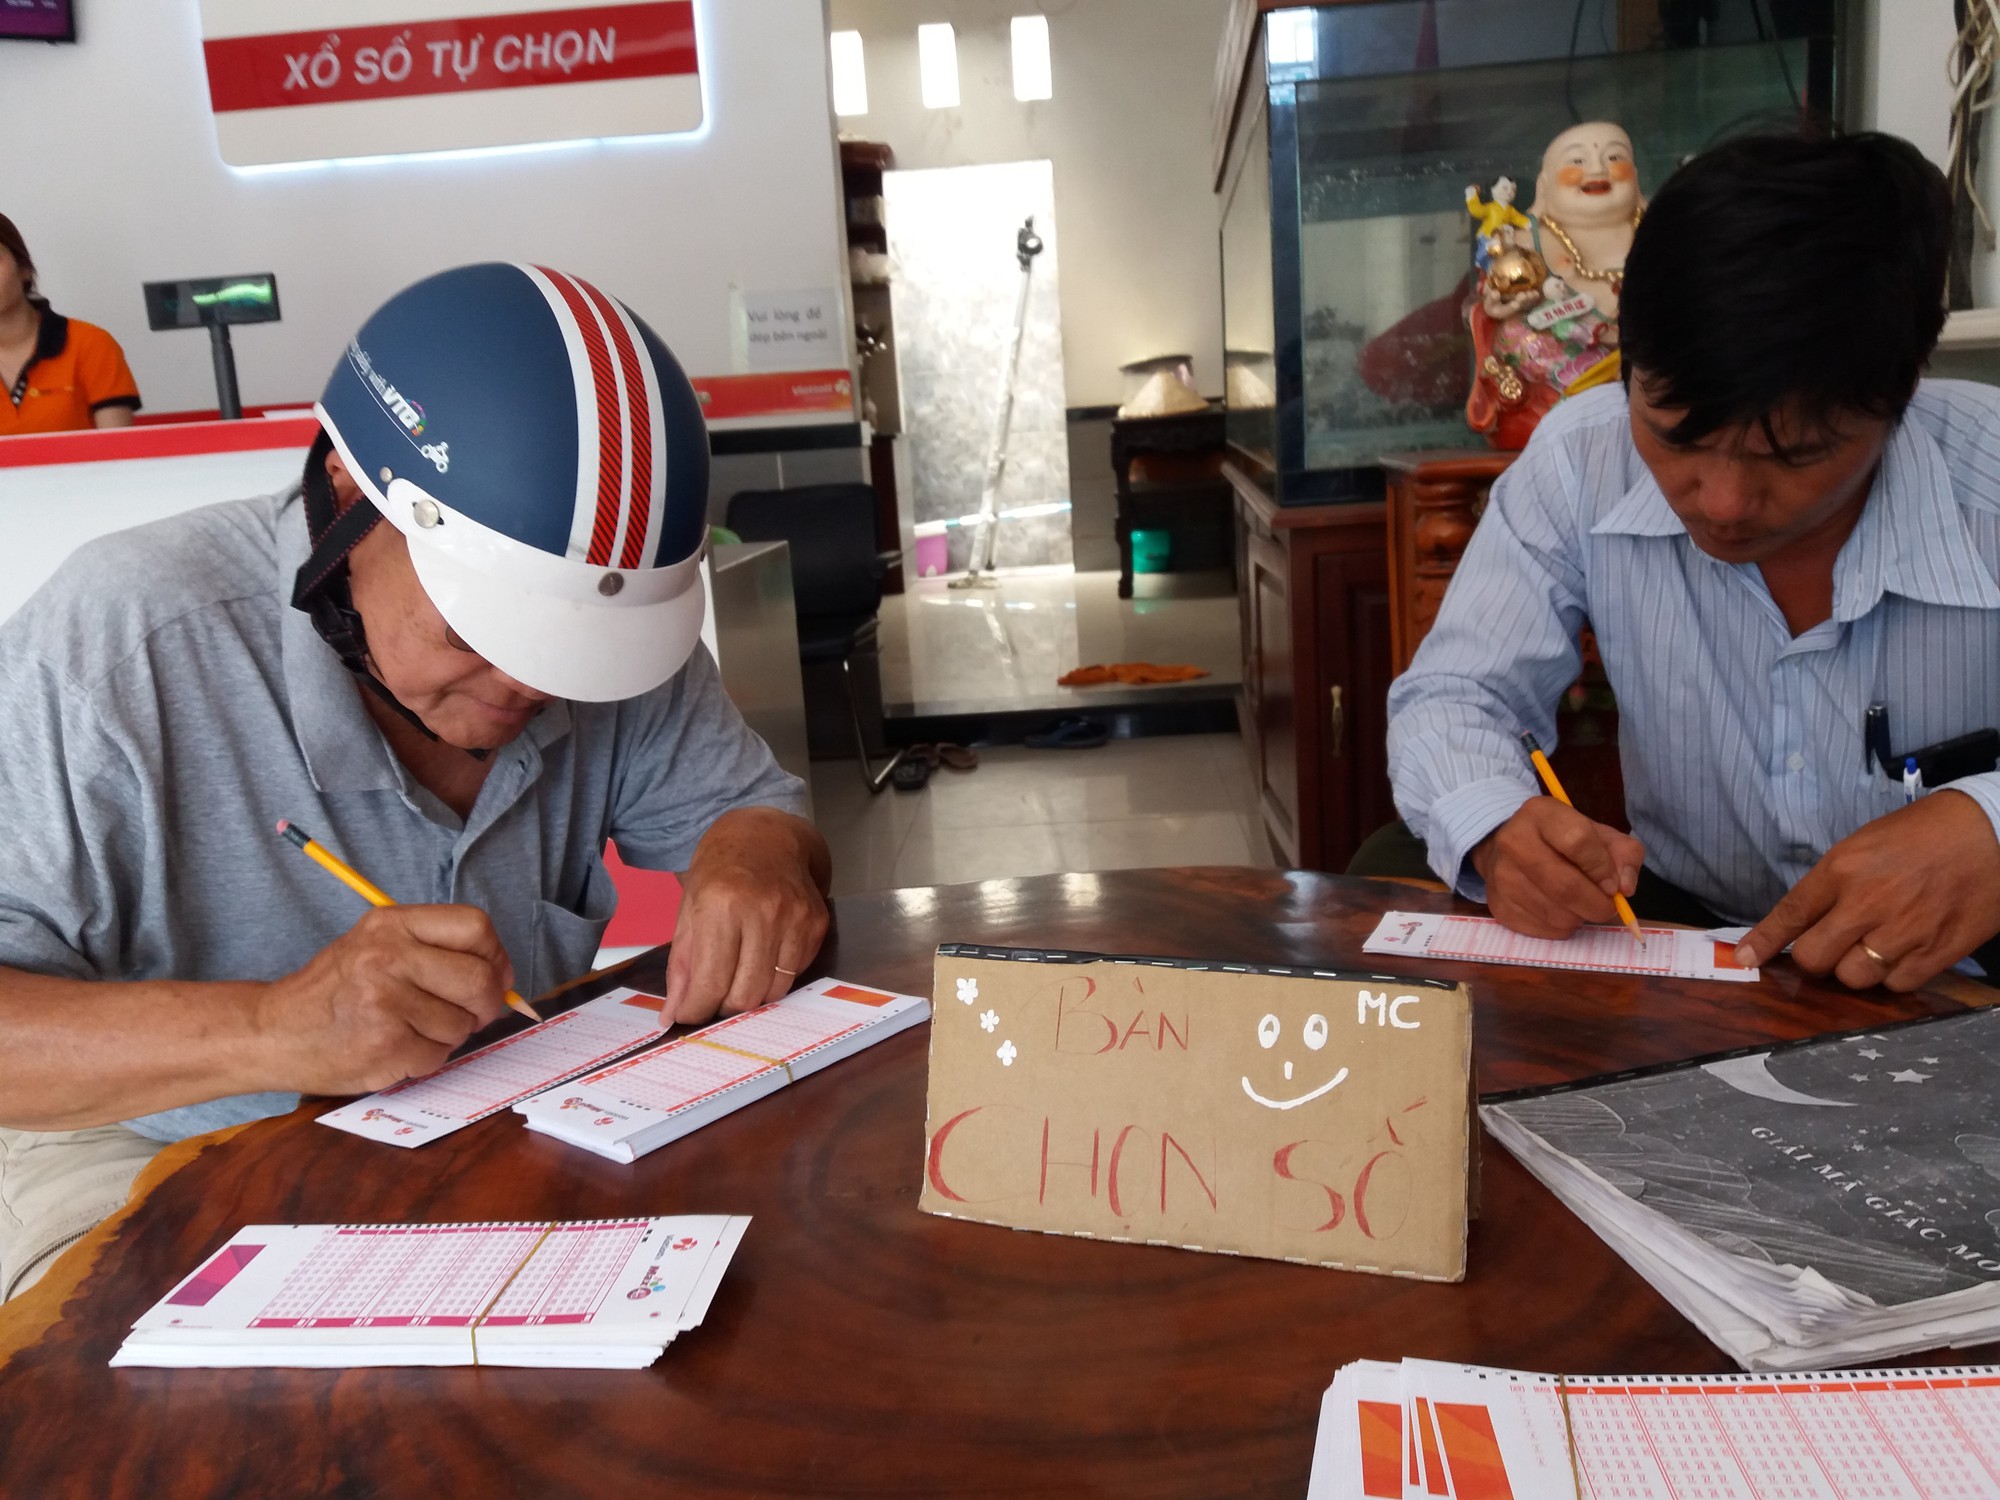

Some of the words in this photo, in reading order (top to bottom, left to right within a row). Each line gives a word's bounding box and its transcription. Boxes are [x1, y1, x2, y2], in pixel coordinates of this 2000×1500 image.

[283, 33, 341, 90] XỔ
[354, 29, 413, 85] SỐ
[425, 32, 485, 83] TỰ
[493, 26, 616, 74] CHỌN
[1016, 976, 1190, 1056] BÀN
[1357, 990, 1421, 1029] MC
[928, 1106, 1217, 1231] CHỌN
[1273, 1096, 1427, 1240] SỐ
